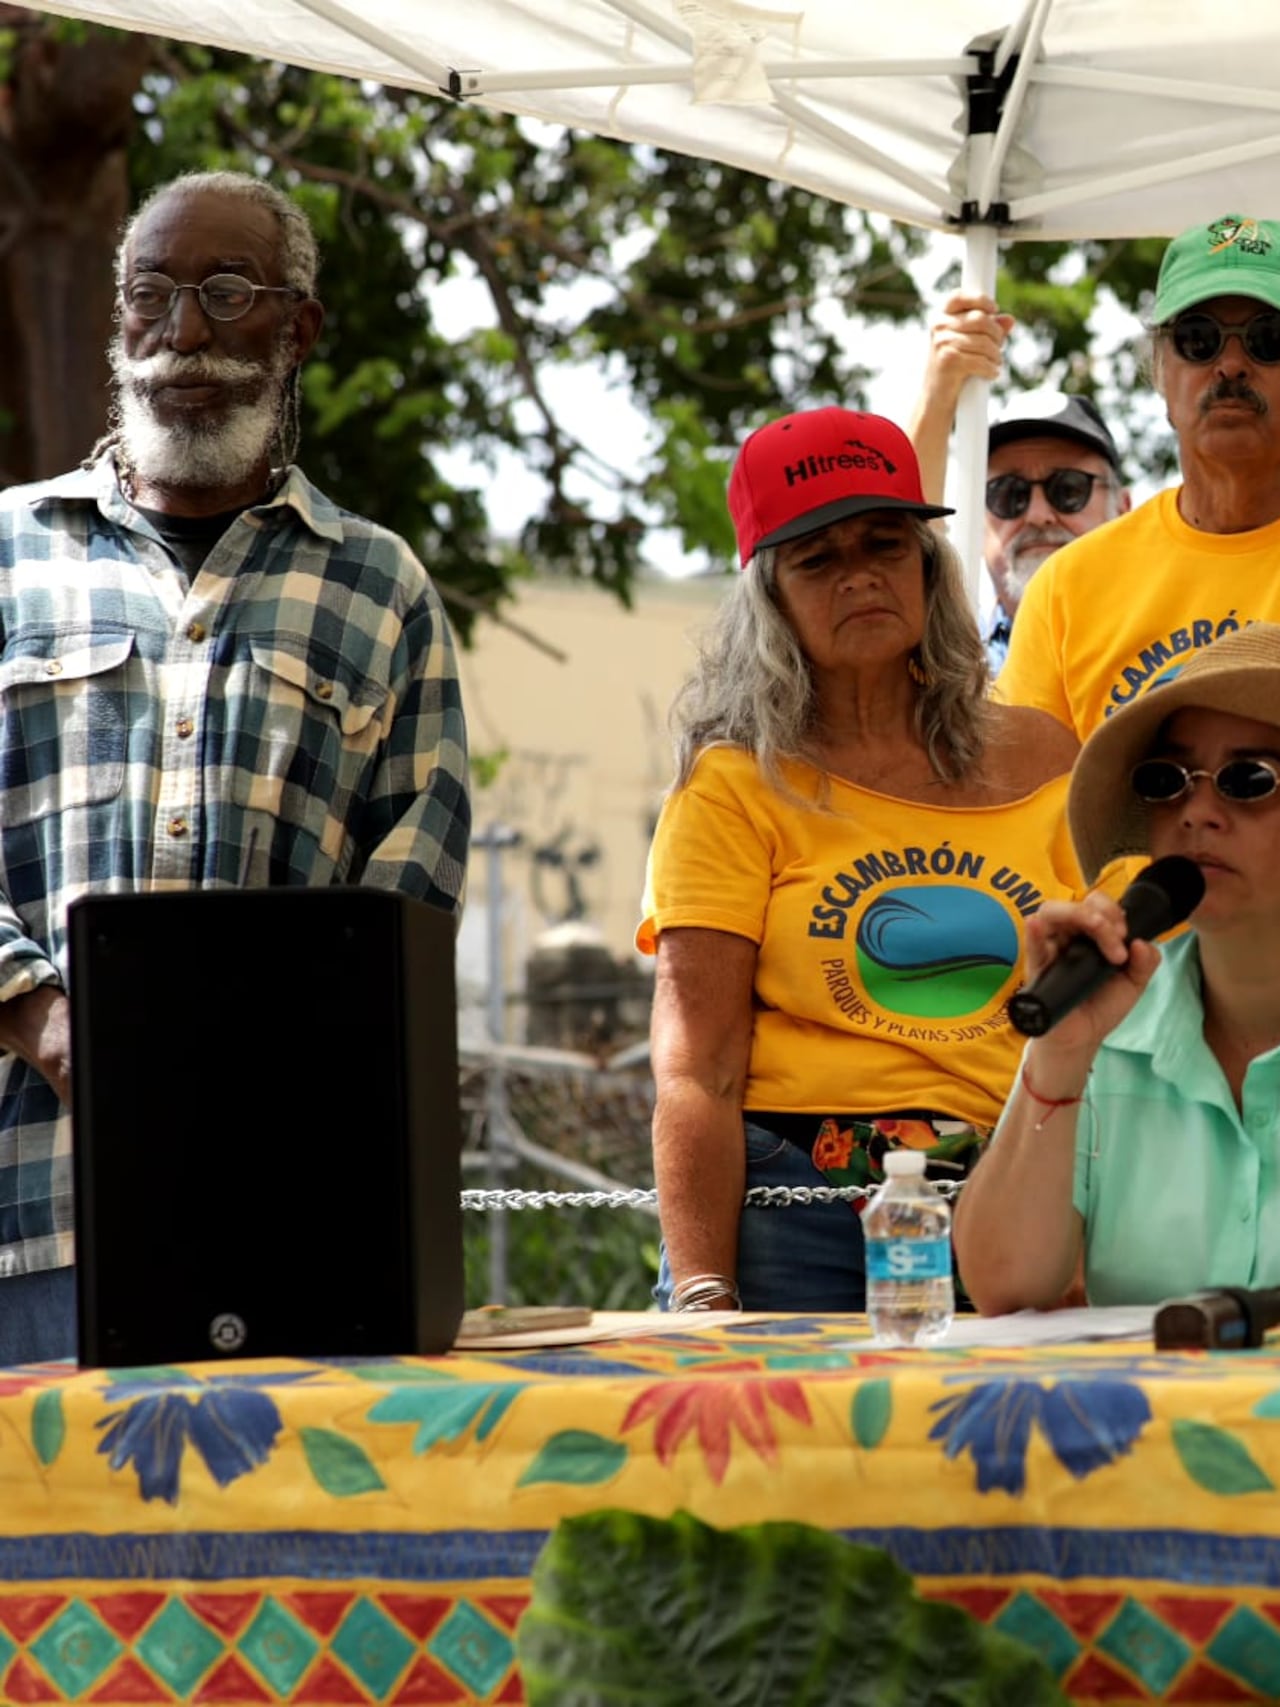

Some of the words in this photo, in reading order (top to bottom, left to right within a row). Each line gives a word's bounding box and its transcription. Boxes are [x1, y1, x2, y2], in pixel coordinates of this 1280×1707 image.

[808, 841, 985, 939] ESCAMBRÓN
[821, 958, 872, 1025] PARQUES
[872, 1015, 887, 1030] Y
[887, 1022, 950, 1042] PLAYAS
